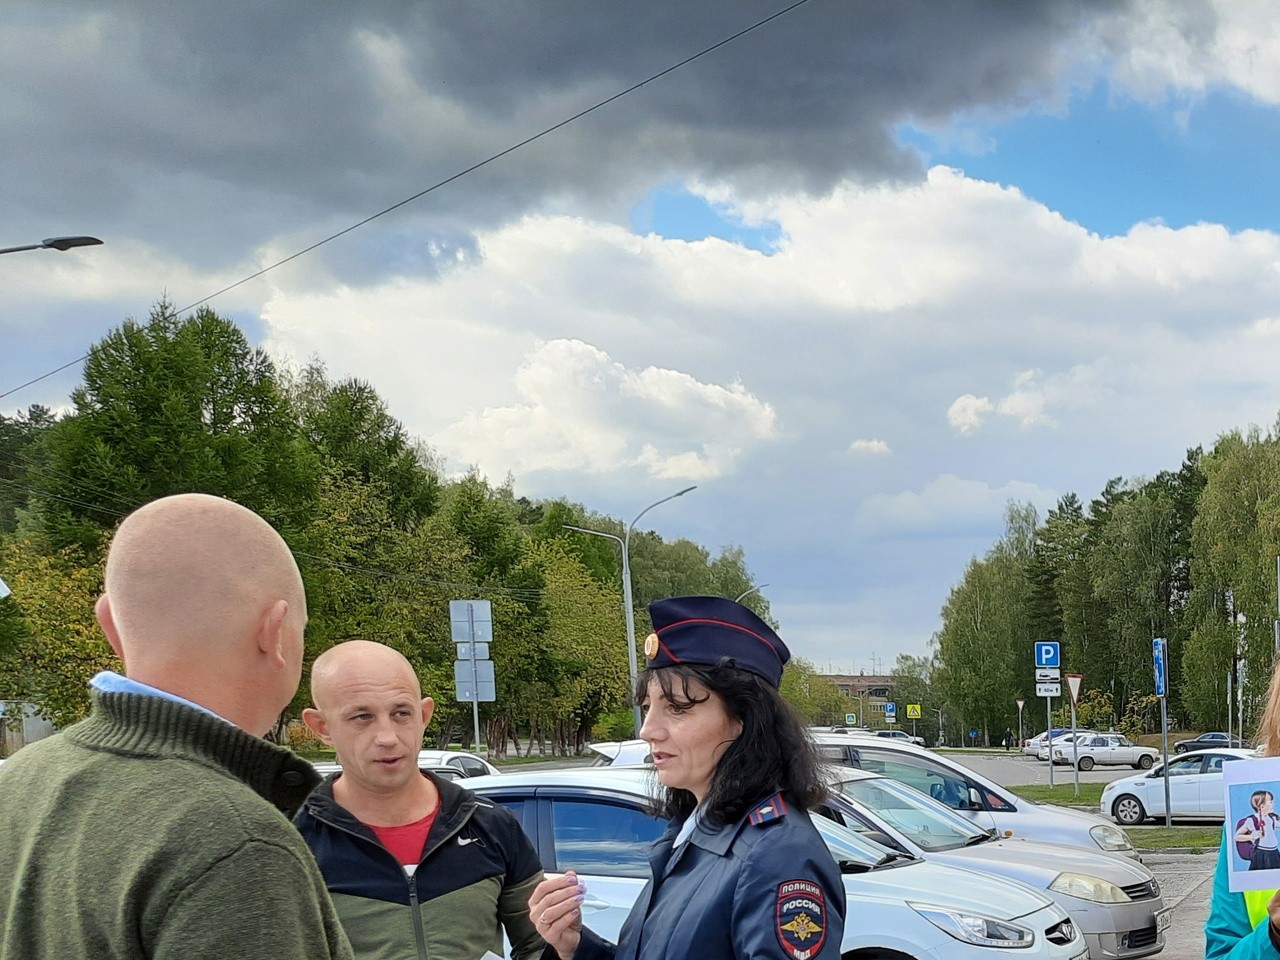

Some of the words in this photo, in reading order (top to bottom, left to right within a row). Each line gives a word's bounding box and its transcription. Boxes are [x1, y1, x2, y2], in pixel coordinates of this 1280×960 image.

[1041, 645, 1054, 664] P
[887, 703, 893, 712] P
[782, 883, 820, 896] ПОЛИЦИЯ
[783, 899, 821, 915] РОССИЯ
[793, 948, 810, 960] МВД
